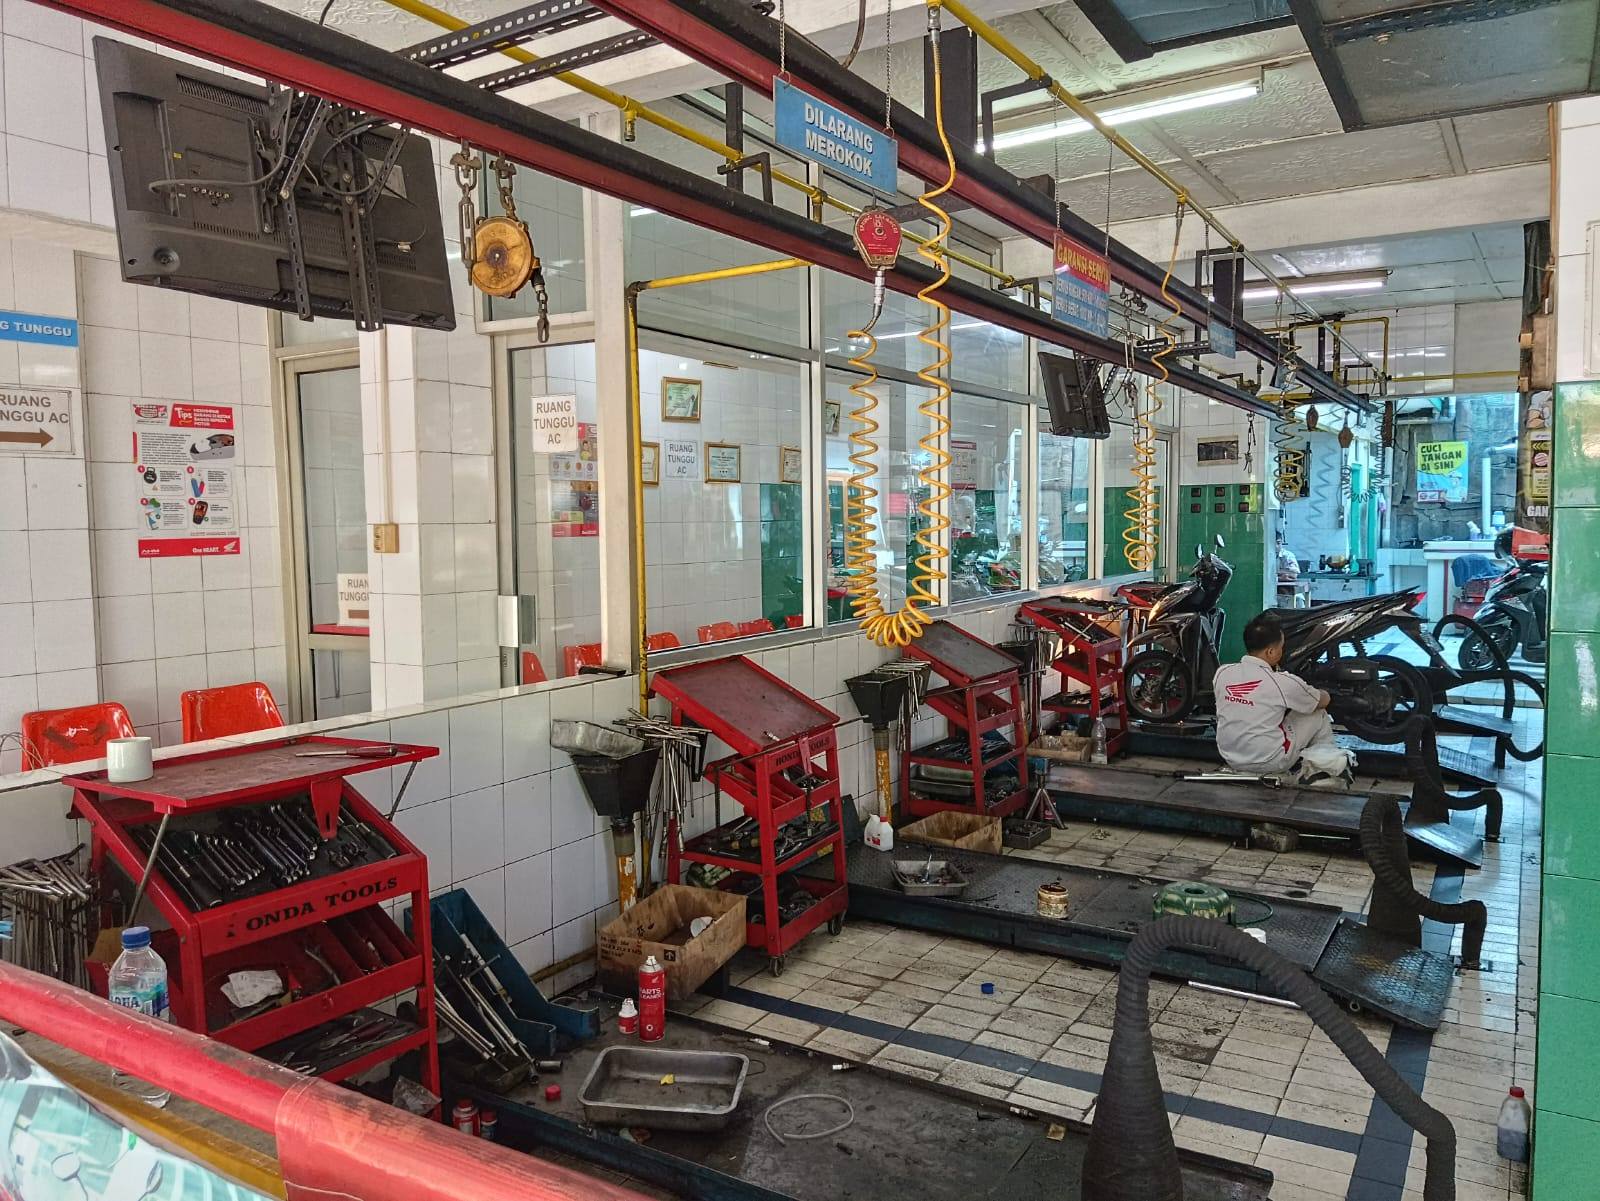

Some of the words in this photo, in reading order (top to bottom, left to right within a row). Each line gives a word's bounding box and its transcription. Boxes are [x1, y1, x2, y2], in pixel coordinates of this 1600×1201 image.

[804, 102, 873, 153] DILARANG
[805, 129, 873, 177] MEROKOK
[1057, 243, 1088, 274] GARANSI
[14, 321, 73, 337] TUNGGU
[536, 400, 571, 414] RUANG
[48, 412, 69, 424] AC
[174, 407, 193, 420] Tips
[533, 416, 575, 430] TUNGGU
[547, 433, 561, 445] AC
[669, 443, 694, 453] RUANG
[1421, 444, 1442, 454] CUCI
[668, 454, 695, 464] TUNGGU
[1422, 450, 1462, 462] TANGAN
[677, 466, 687, 474] AC
[1421, 463, 1431, 471] DI
[1434, 460, 1455, 470] SINI
[1224, 695, 1255, 706] HONDA
[776, 750, 801, 767] HOND
[809, 736, 831, 751] OOLS
[226, 901, 315, 938] ONDA
[325, 877, 398, 908] TOOLS
